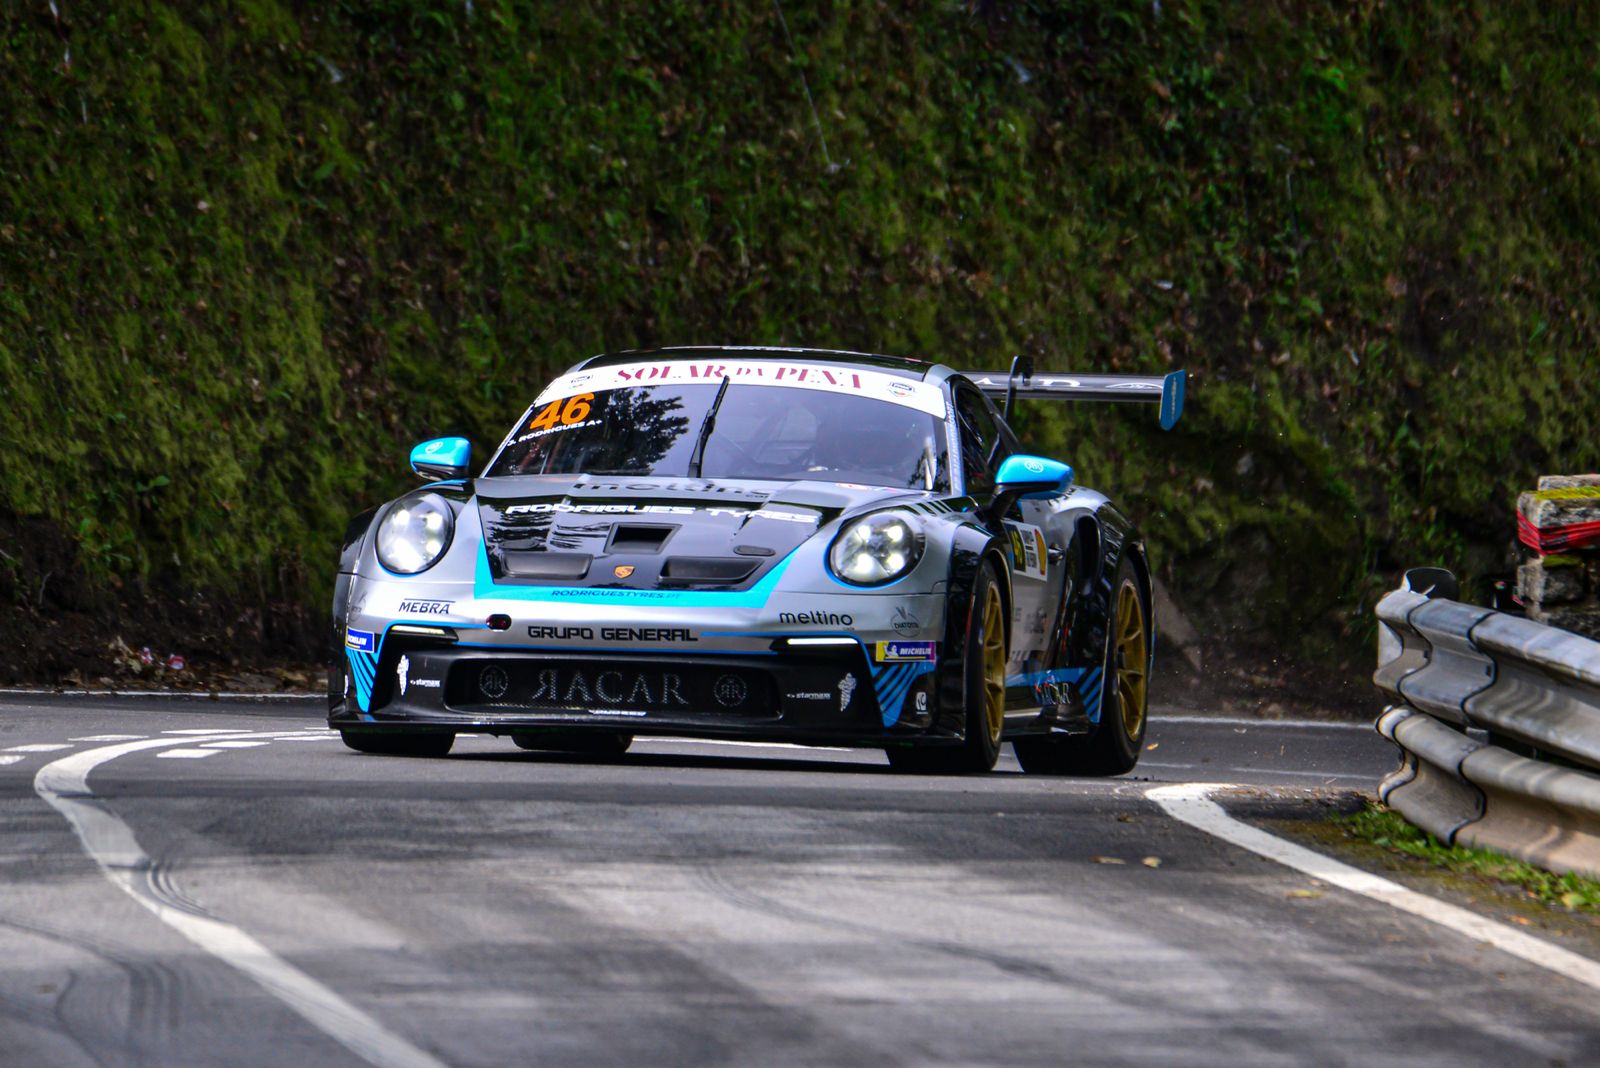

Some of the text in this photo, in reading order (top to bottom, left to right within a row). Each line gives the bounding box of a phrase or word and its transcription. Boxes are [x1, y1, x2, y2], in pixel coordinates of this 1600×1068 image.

[614, 365, 726, 382] SOLAR
[529, 391, 595, 431] 46
[518, 421, 585, 442] RODRIGUES
[505, 504, 819, 523] RODRIGUES TYRES
[398, 600, 451, 615] MEBRA
[779, 610, 853, 626] meltino
[527, 626, 698, 642] GRUPO GENERAL
[899, 647, 932, 656] MICHELIN
